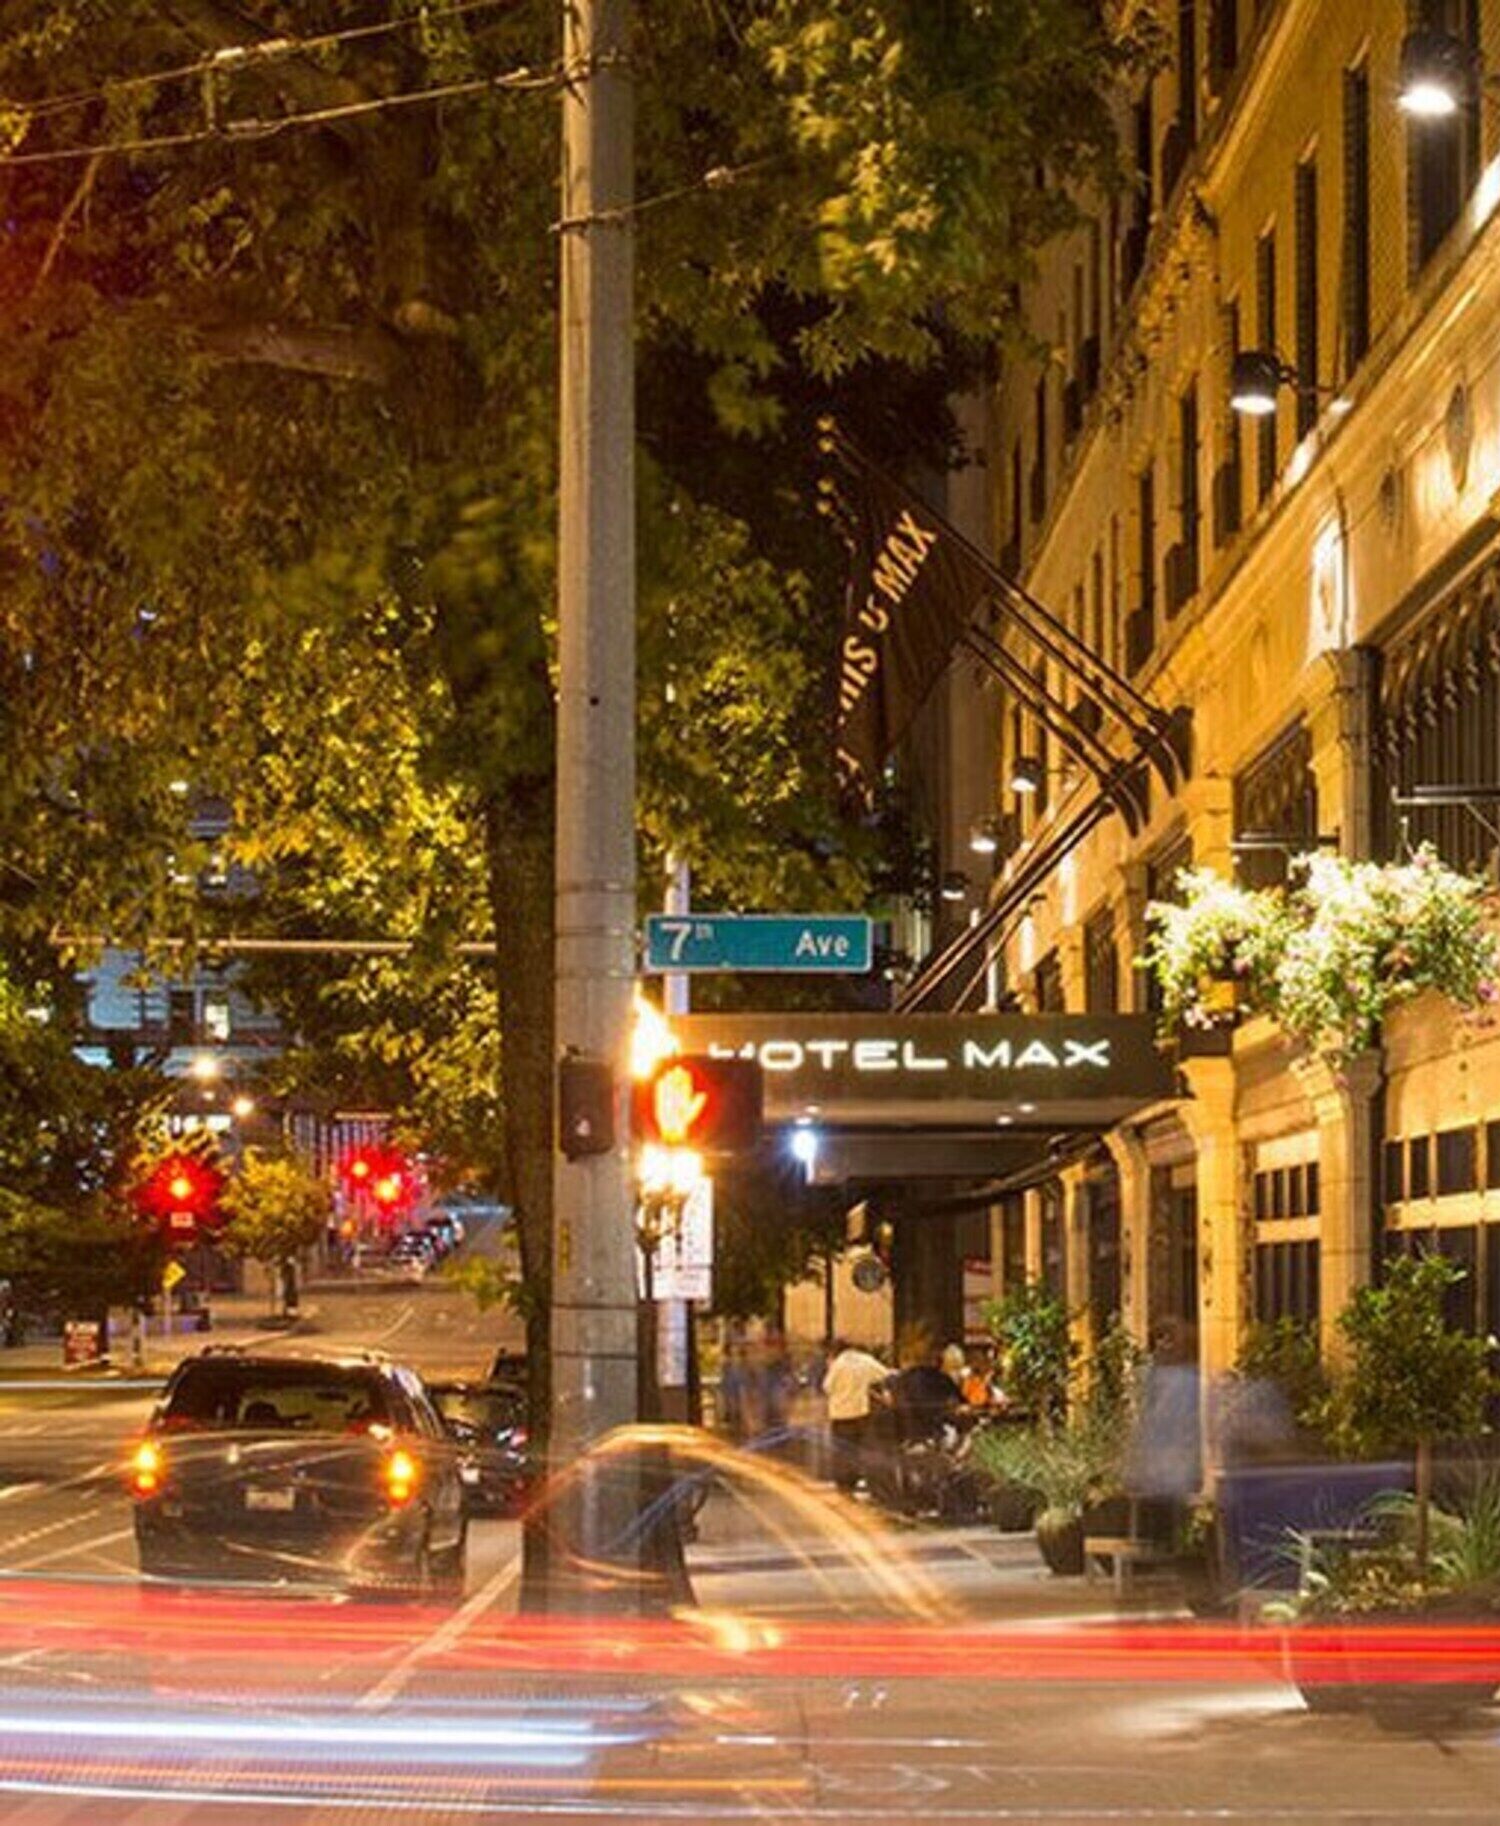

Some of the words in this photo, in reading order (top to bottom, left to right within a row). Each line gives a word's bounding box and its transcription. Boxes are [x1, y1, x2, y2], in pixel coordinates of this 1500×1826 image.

[839, 636, 879, 726] IS
[872, 509, 937, 604] MAX
[795, 930, 850, 957] Ave
[964, 1039, 1110, 1067] MAX
